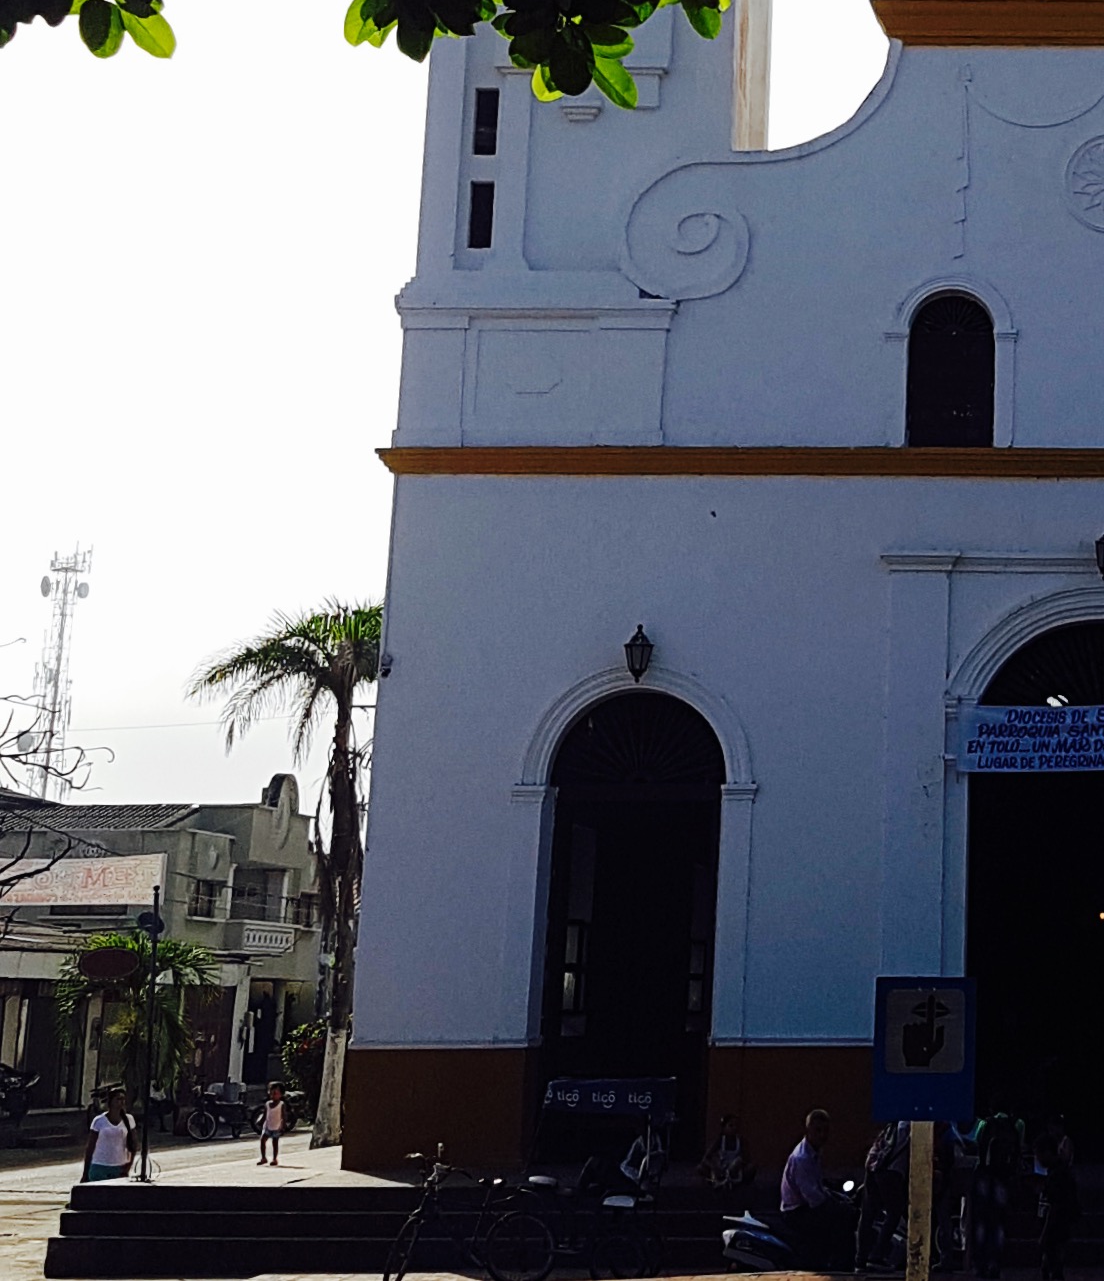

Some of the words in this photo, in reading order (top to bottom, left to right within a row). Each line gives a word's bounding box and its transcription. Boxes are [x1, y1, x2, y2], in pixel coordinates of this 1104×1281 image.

[1005, 709, 1067, 724] DIOCESIS
[1071, 709, 1089, 724] DE
[977, 723, 1060, 738] PARROQUIA
[967, 740, 985, 754] EN
[1032, 740, 1051, 753] UN
[1052, 738, 1091, 753] MAR
[977, 755, 1018, 769] LUGAR
[1020, 756, 1035, 769] DE
